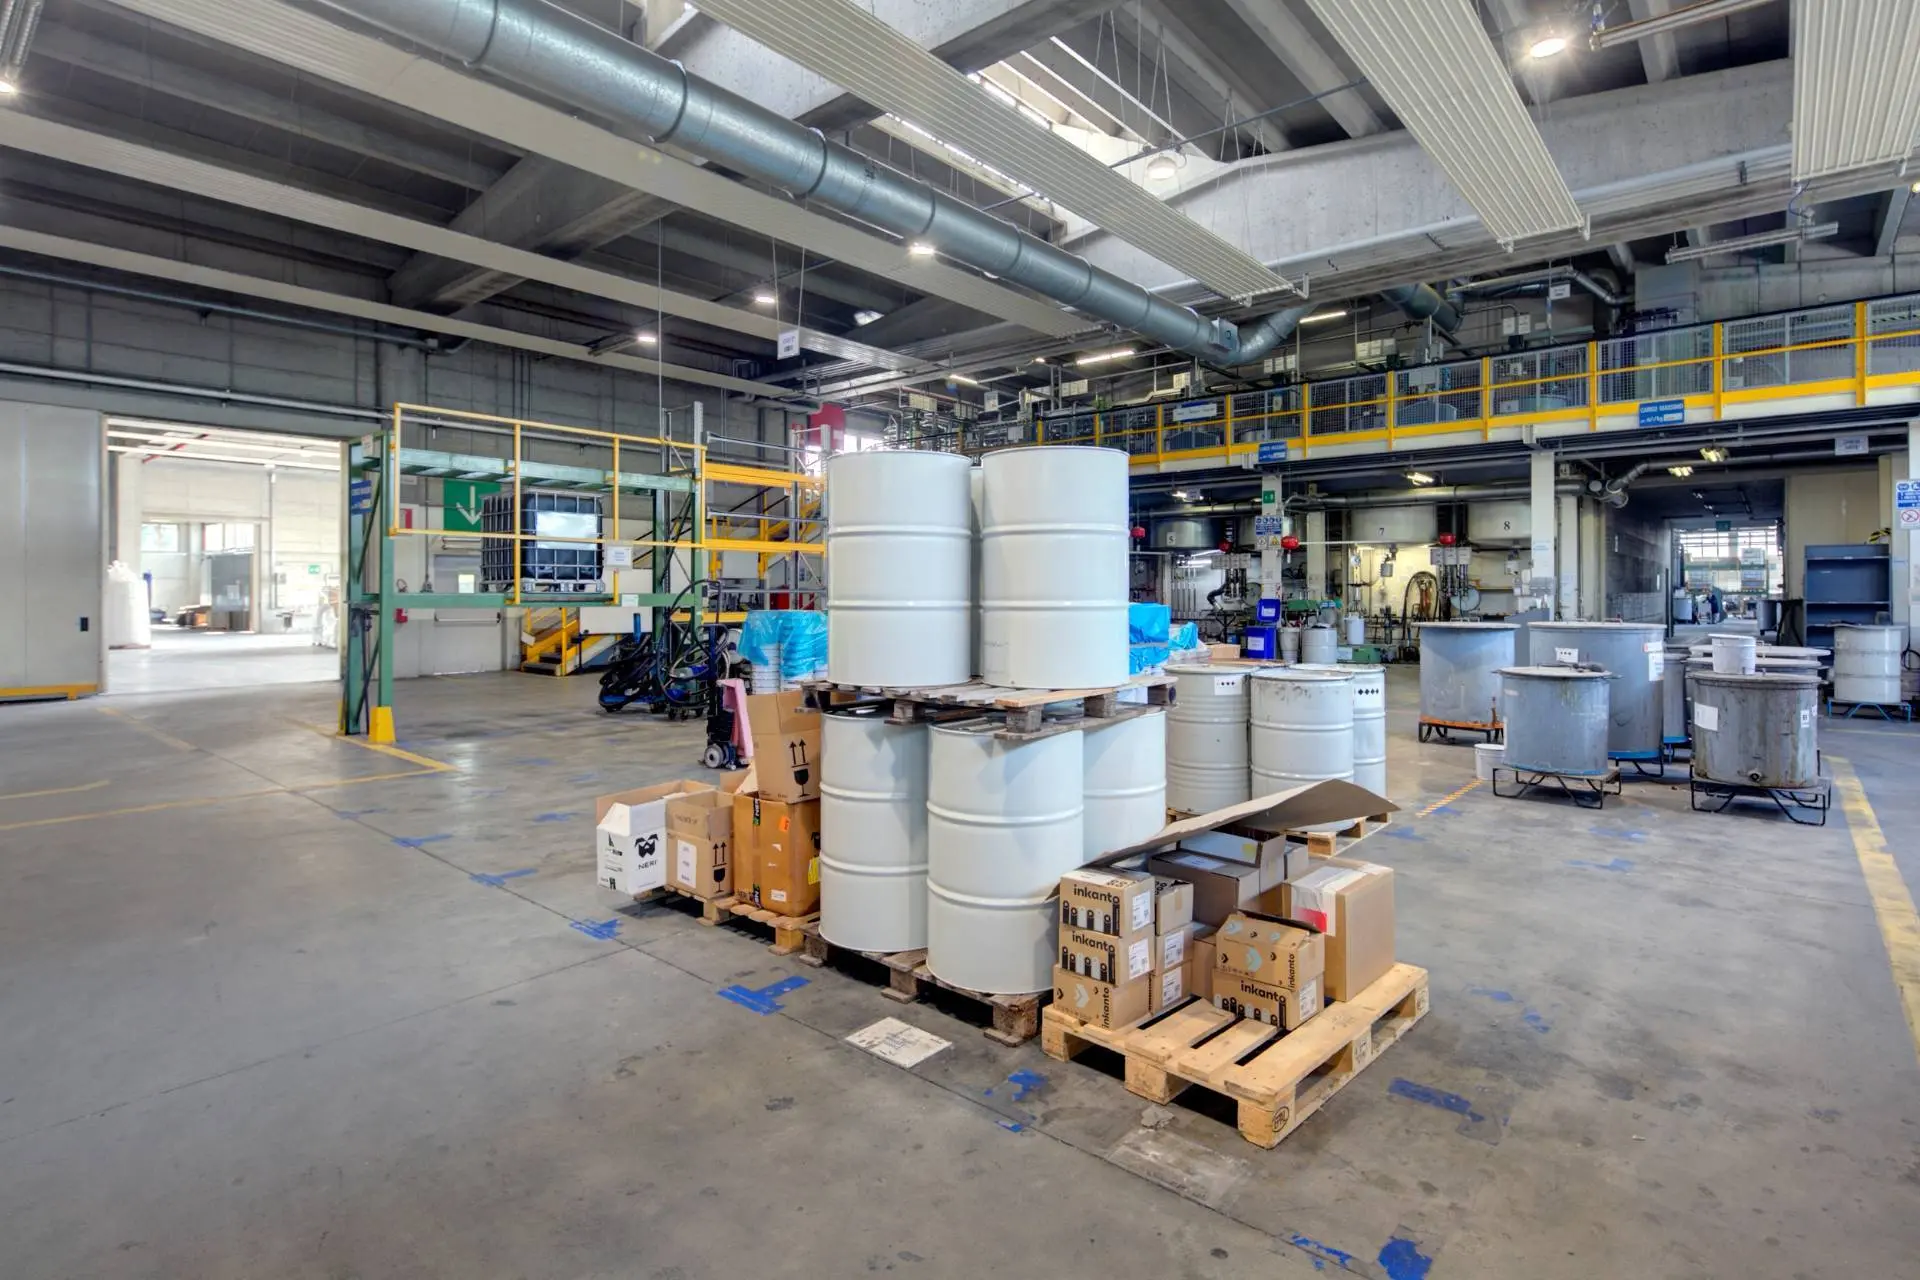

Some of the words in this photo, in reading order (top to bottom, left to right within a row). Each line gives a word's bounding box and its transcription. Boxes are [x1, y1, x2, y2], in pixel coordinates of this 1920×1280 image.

[1379, 527, 1385, 536] 7
[1503, 520, 1511, 531] 8
[638, 860, 657, 870] NERI
[1073, 884, 1120, 904] inkanto
[1072, 931, 1115, 953] inkanto
[1240, 980, 1286, 1003] inkanto
[1102, 987, 1110, 1029] inkanto
